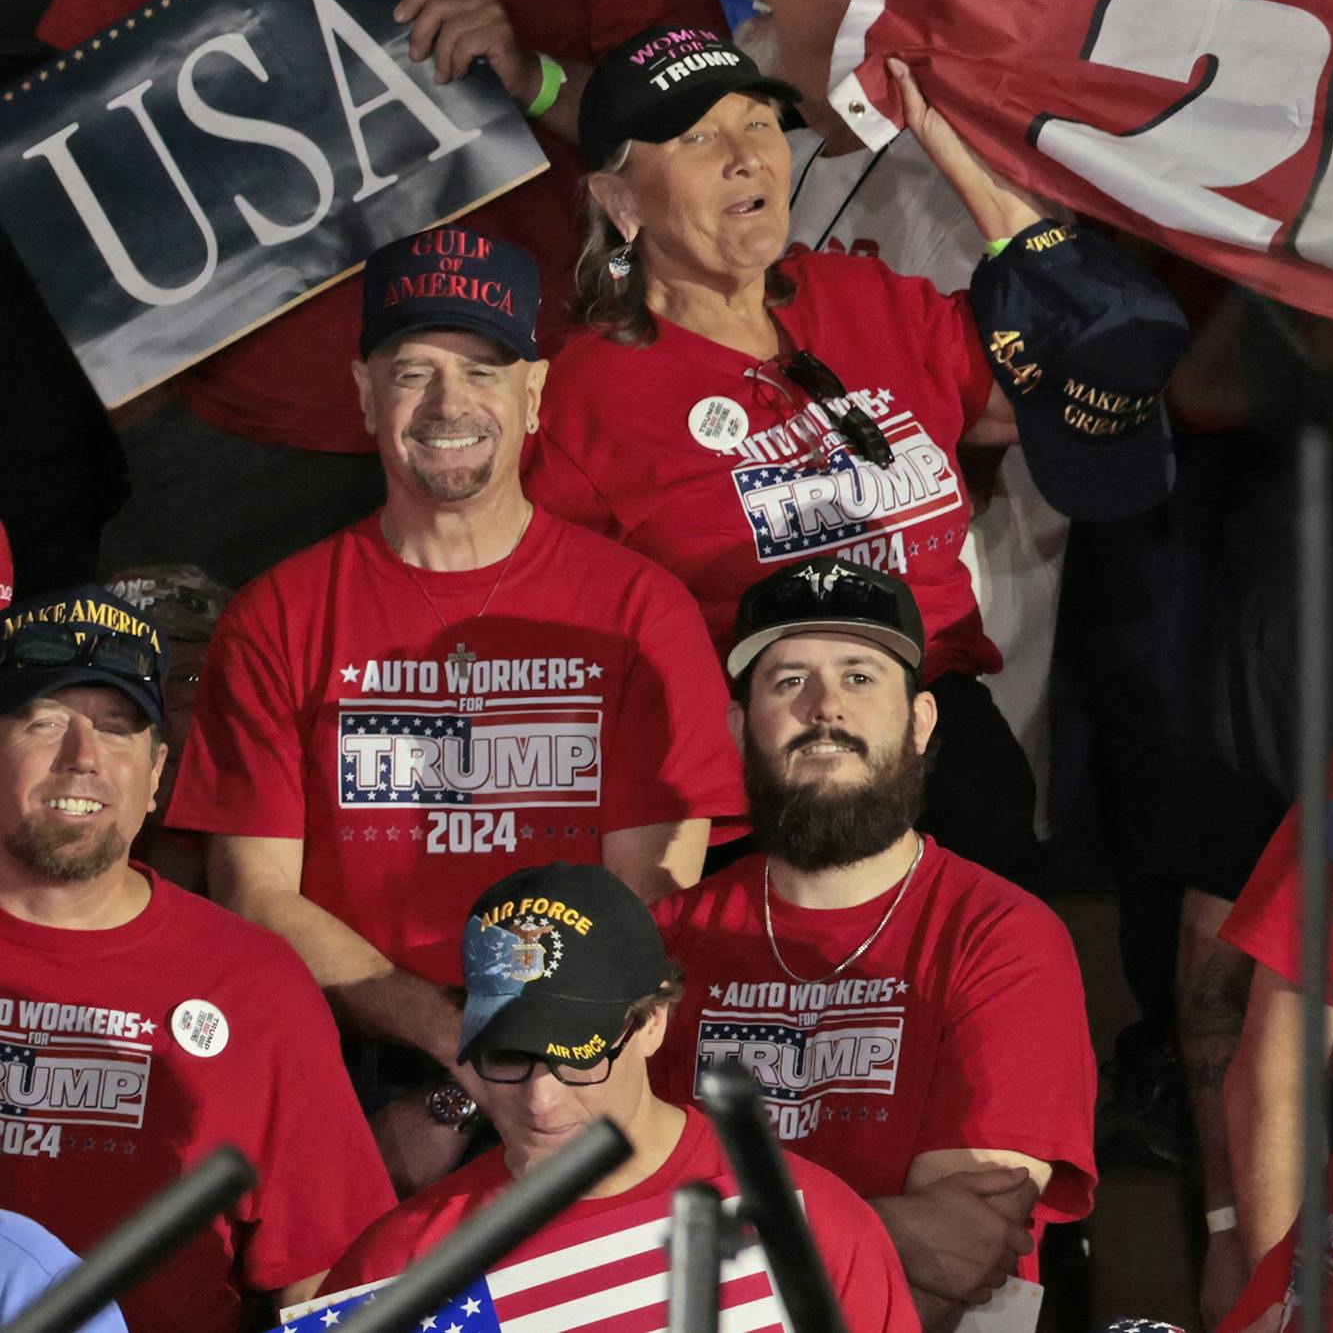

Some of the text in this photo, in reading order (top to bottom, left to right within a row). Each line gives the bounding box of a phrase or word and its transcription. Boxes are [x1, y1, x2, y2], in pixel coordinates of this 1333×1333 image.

[667, 41, 705, 59] FOR
[649, 51, 740, 92] TRUMP
[411, 229, 493, 260] GULF
[439, 257, 464, 272] OF
[384, 273, 514, 317] AMERICA
[1063, 378, 1129, 413] MAKE
[746, 443, 945, 543] TRUMP
[2, 602, 68, 641] MAKE
[69, 598, 162, 655] AMERICA
[361, 657, 585, 695] AUTO WORKERS
[459, 697, 484, 712] FOR
[343, 734, 597, 791] TRUMP
[426, 811, 517, 854] 2024
[480, 897, 594, 937] AIR FORCE
[721, 976, 896, 1012] AUTO WORKERS
[19, 999, 141, 1039] WORKERS
[798, 1013, 819, 1027] FOR
[28, 1031, 50, 1046] FOR
[546, 1033, 607, 1061] AIR FORCE
[0, 1119, 63, 1158] 024
